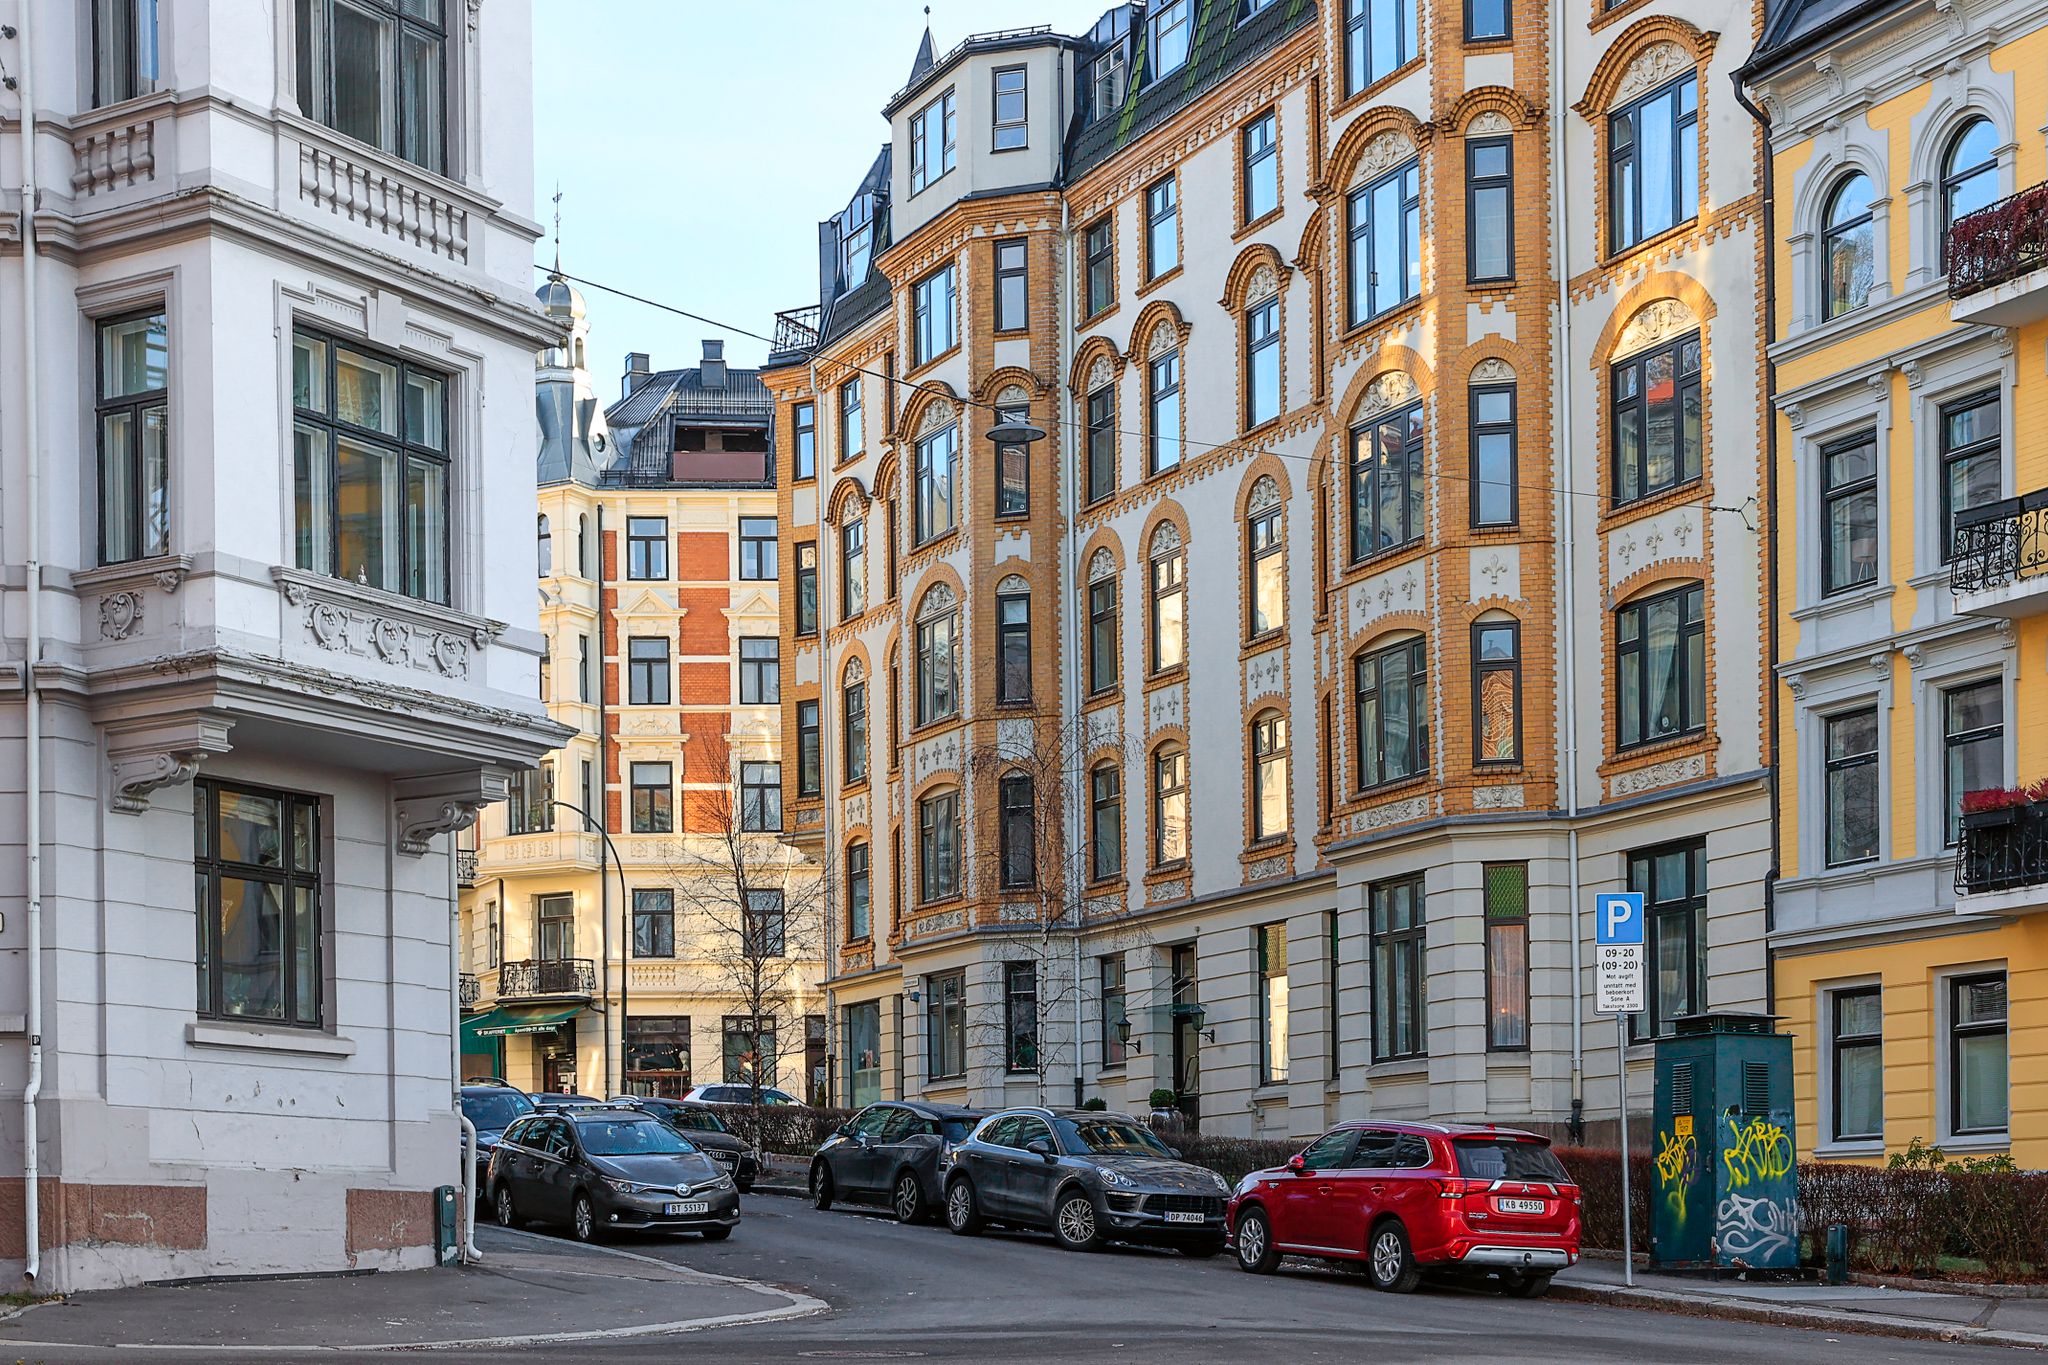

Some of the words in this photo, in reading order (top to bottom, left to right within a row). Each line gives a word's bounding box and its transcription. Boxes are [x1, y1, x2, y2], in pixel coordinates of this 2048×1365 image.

[1607, 900, 1632, 938] P
[671, 1204, 681, 1213] BT
[684, 1203, 705, 1212] 55137
[1505, 1200, 1516, 1209] KB
[1519, 1201, 1543, 1211] 49550
[1170, 1213, 1180, 1221] DP
[1182, 1213, 1203, 1222] 74046
